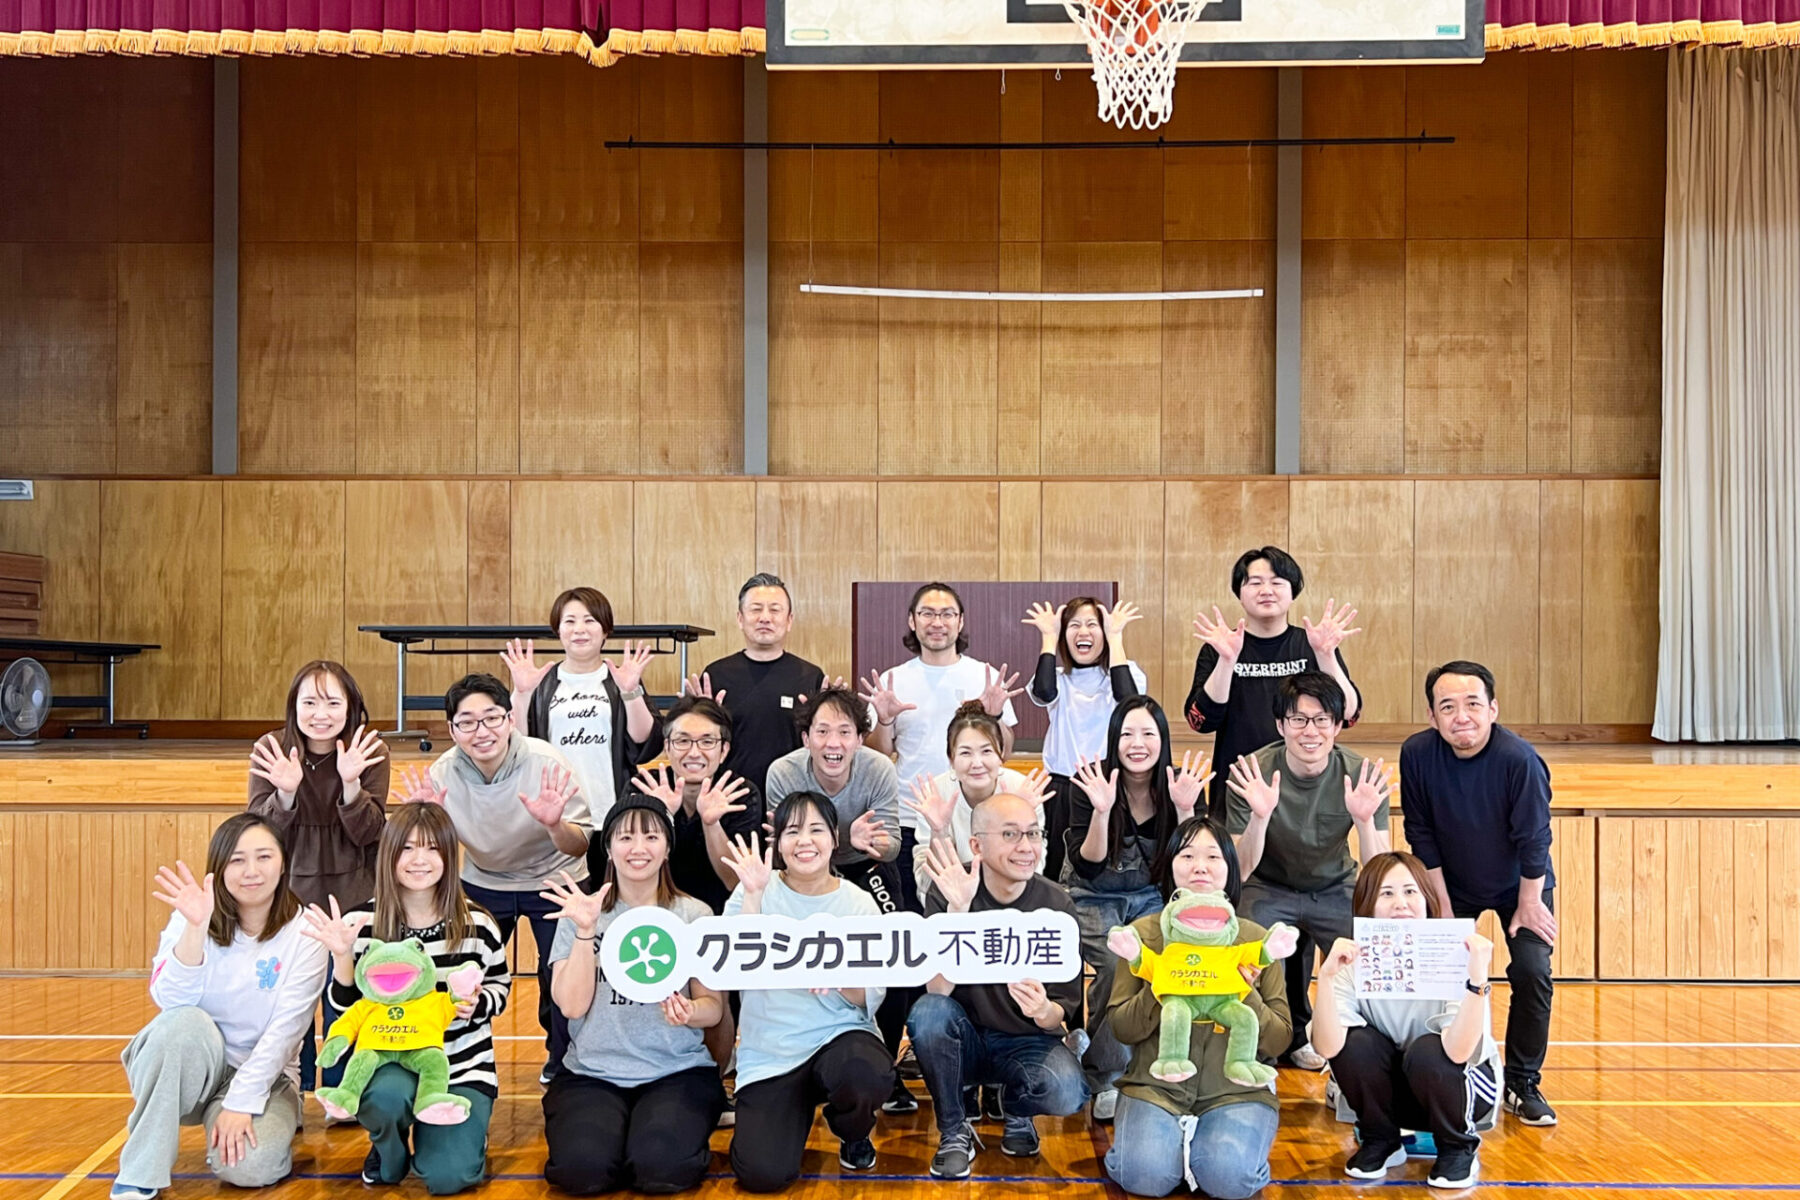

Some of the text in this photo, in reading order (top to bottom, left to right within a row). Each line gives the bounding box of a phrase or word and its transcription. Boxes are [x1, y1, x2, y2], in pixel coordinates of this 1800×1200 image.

[1233, 658, 1308, 674] OVERPRINT
[567, 705, 598, 719] with
[560, 727, 607, 746] others
[697, 927, 1063, 972] クラシカエル 不動産
